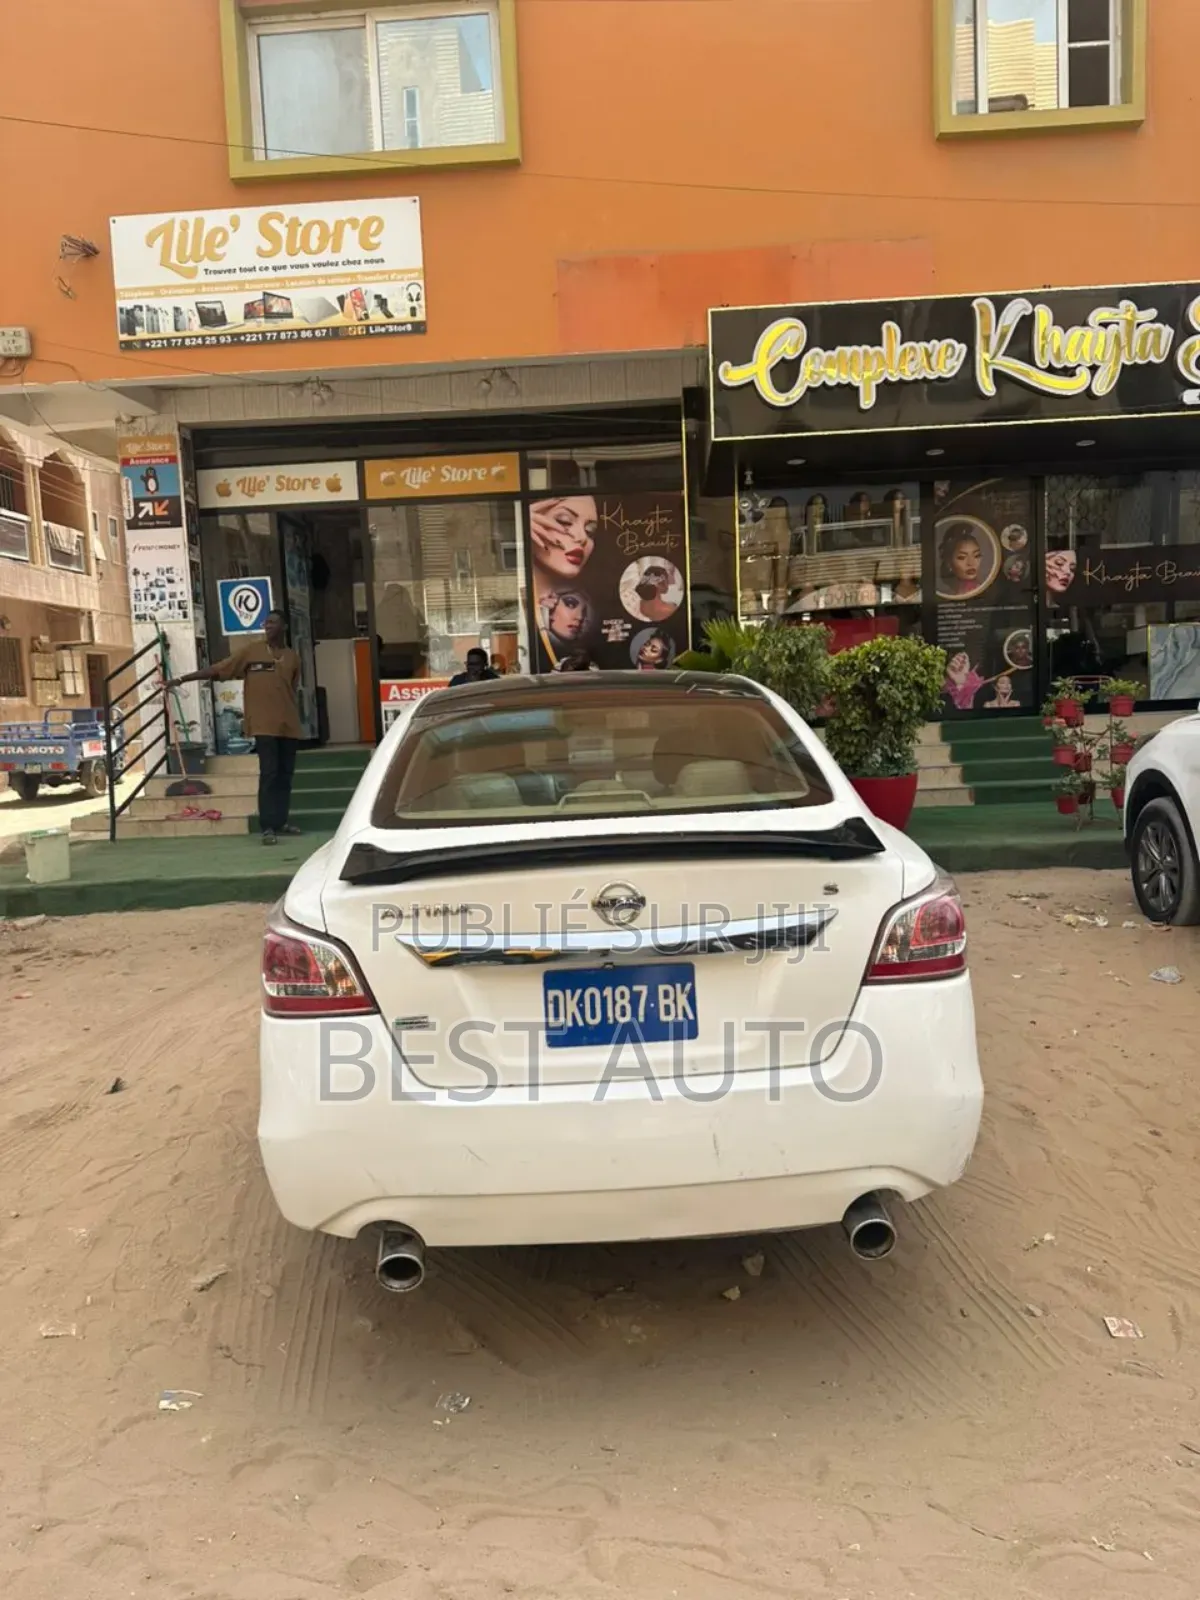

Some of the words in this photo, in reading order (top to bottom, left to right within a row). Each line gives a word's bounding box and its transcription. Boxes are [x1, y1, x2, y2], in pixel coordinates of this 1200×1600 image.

[144, 215, 241, 279] Lile'
[256, 211, 385, 258] Store
[204, 268, 237, 276] Trouvez
[239, 265, 257, 273] tout
[271, 264, 287, 272] que
[290, 262, 310, 270] vous
[312, 260, 339, 268] voulez
[342, 258, 362, 266] chez
[364, 257, 385, 265] nous
[240, 334, 262, 342] +221
[266, 332, 278, 340] 77
[280, 331, 298, 339] 873
[301, 330, 313, 338] 86
[719, 318, 967, 409] Complexe
[972, 298, 1174, 395] Khayta
[236, 475, 270, 498] Lile'
[275, 474, 320, 491] Store
[400, 464, 436, 489] Lile'
[440, 465, 487, 482] Store
[600, 499, 673, 537] Khayta
[1082, 558, 1152, 592] Khayta
